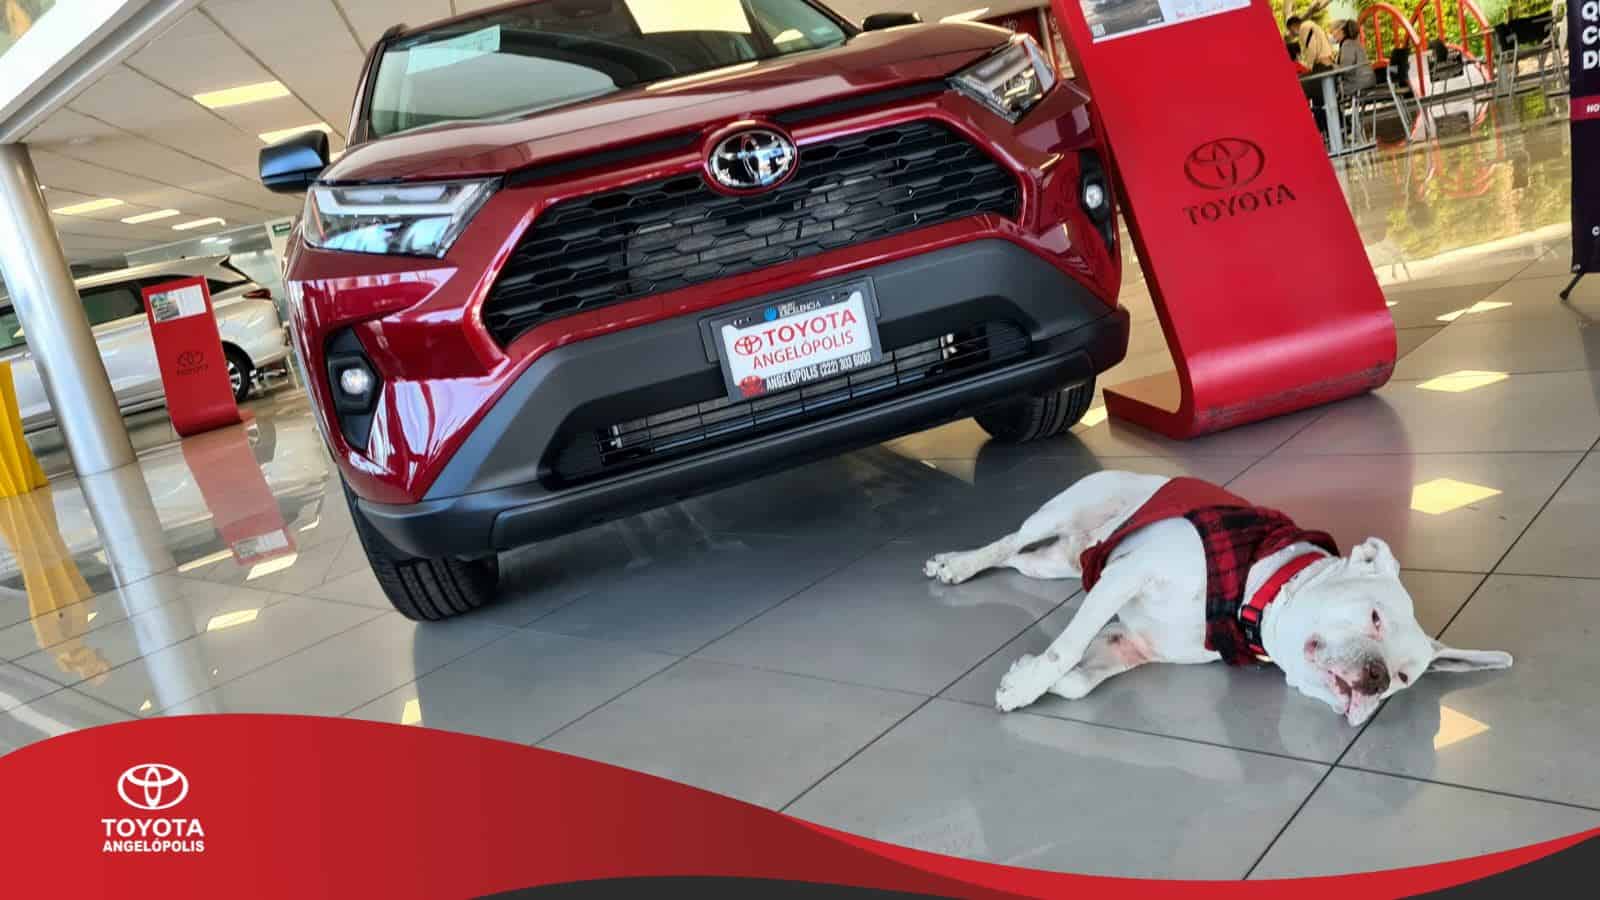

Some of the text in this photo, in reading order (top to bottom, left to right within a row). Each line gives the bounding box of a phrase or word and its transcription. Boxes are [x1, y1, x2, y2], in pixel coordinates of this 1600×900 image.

[1582, 1, 1600, 22] Q
[1582, 25, 1600, 45] C
[1583, 49, 1600, 70] D
[1182, 184, 1297, 225] TOYOTA
[762, 309, 857, 347] TOYOTA
[753, 330, 854, 370] ANGELÓPOLIS
